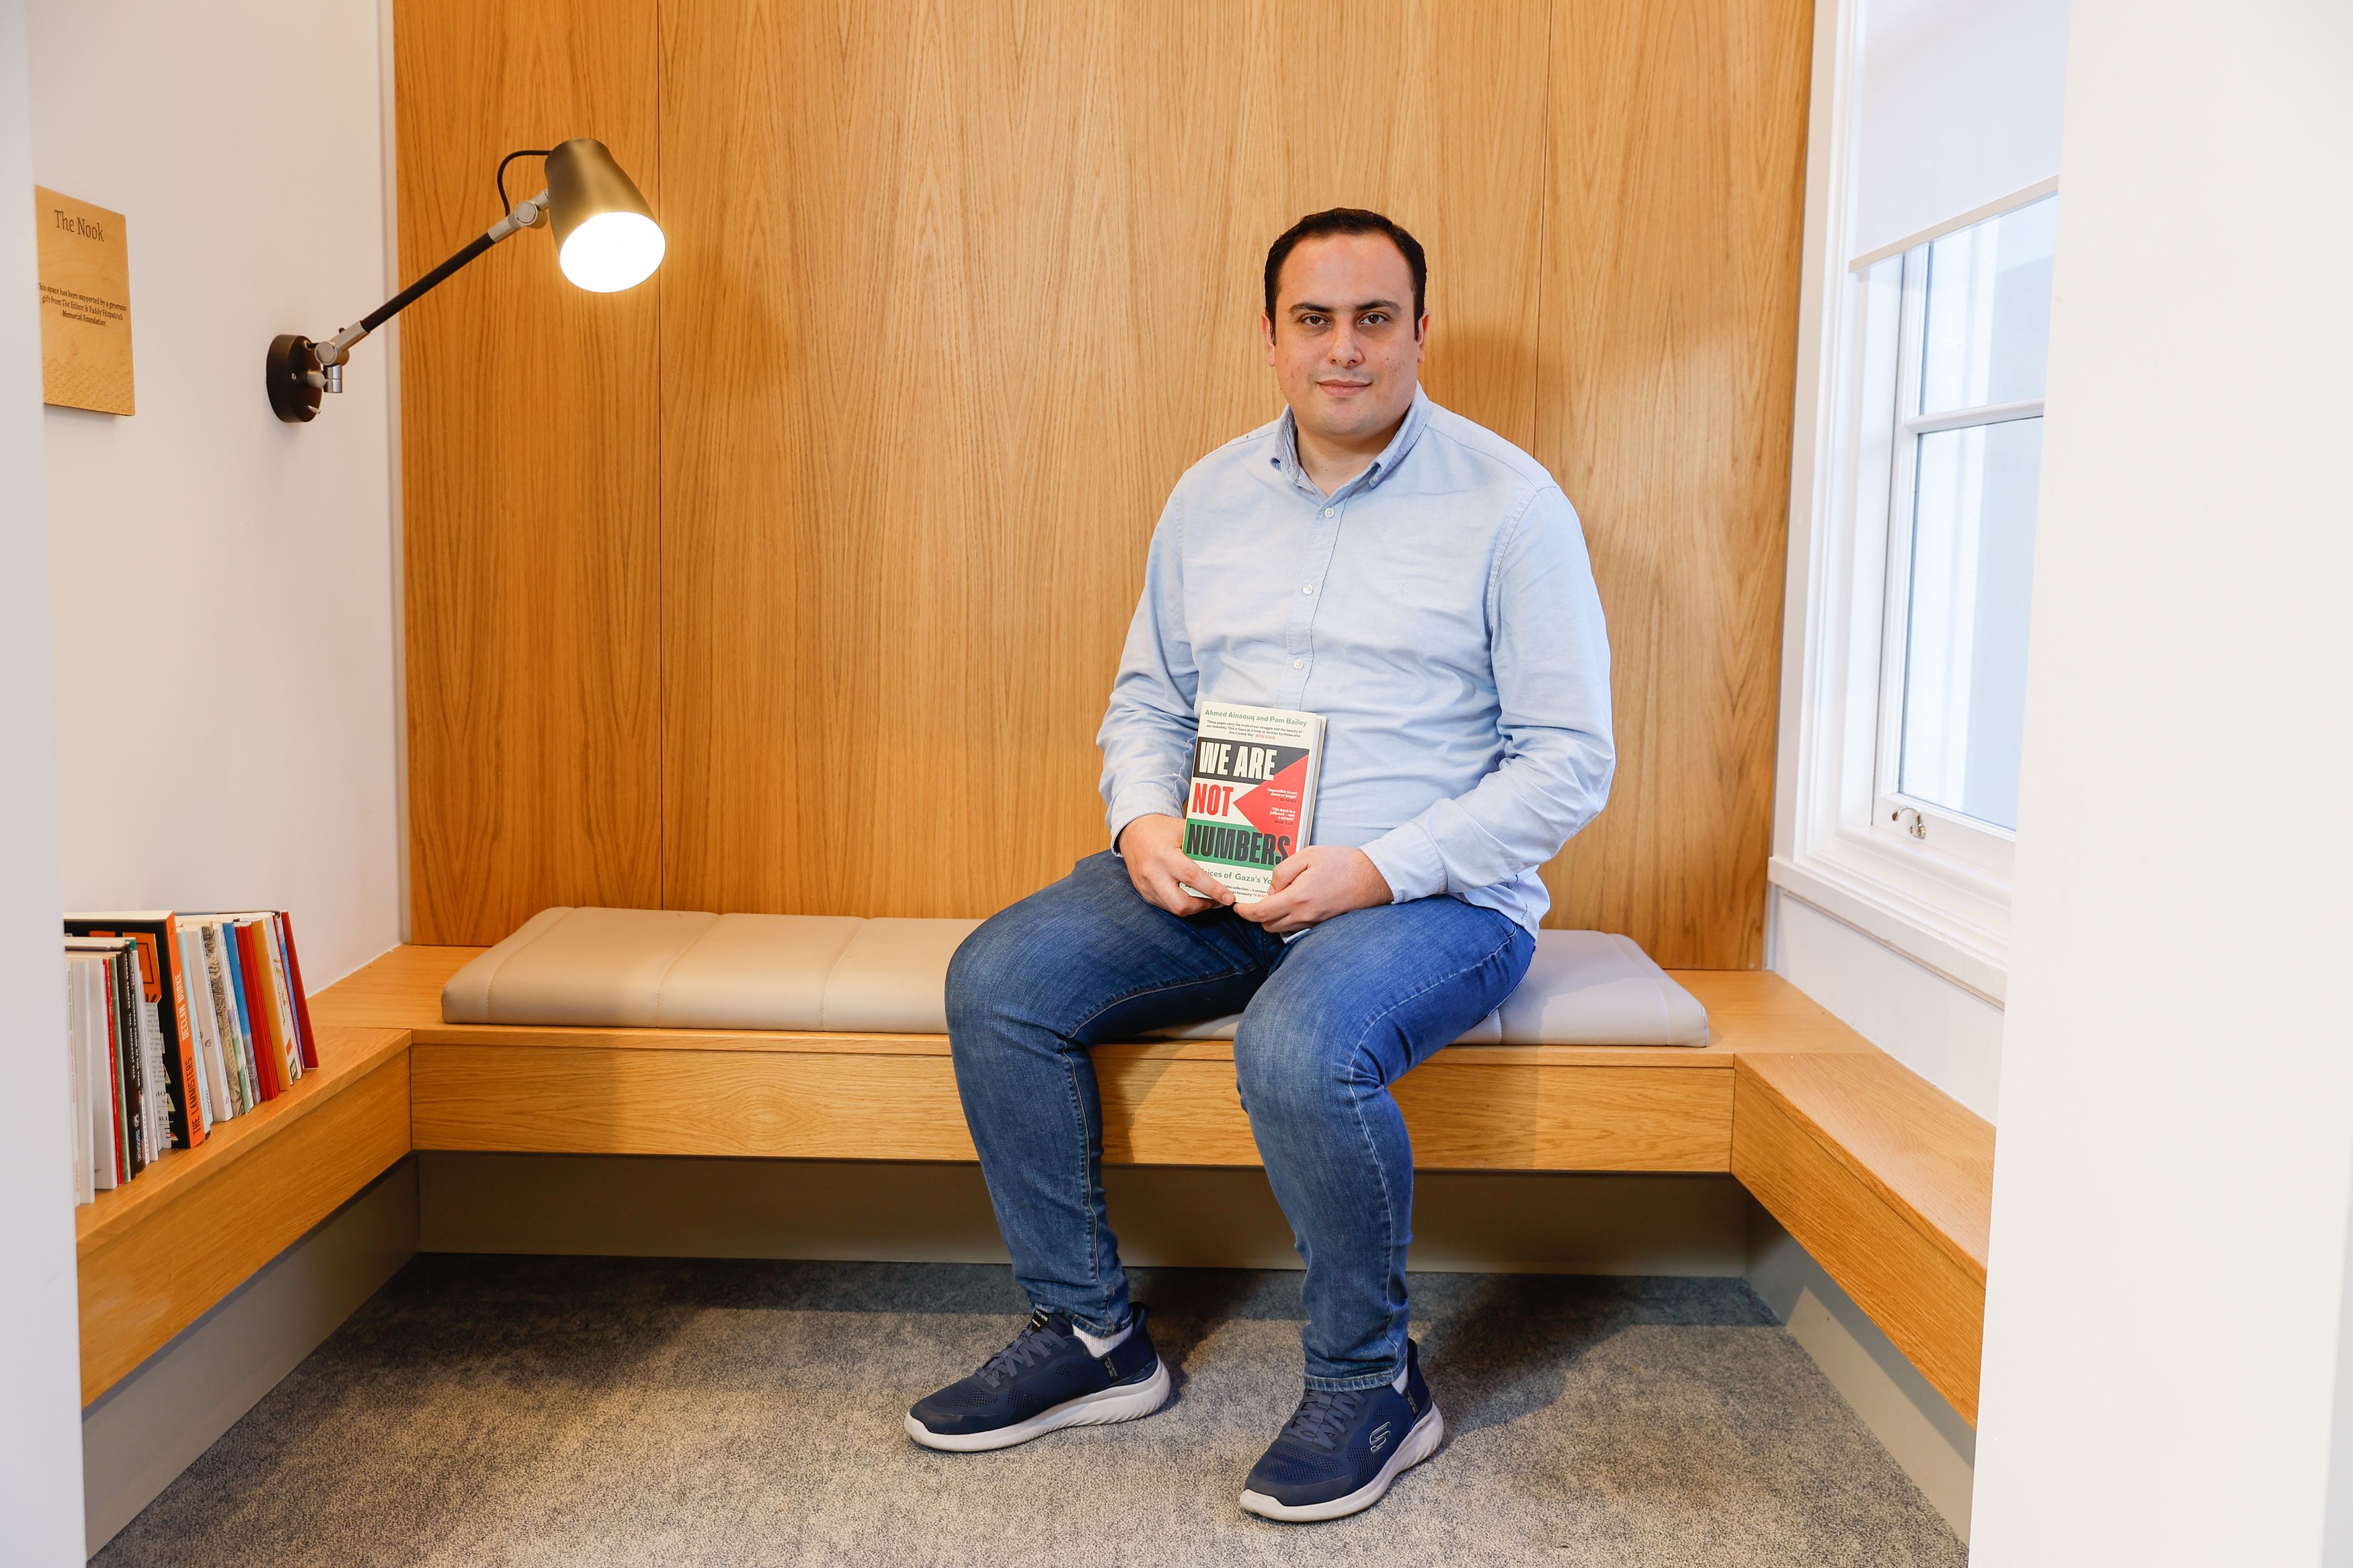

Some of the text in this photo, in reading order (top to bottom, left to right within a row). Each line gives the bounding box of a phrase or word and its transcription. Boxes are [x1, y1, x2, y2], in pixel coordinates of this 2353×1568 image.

[54, 210, 104, 242] The Nook
[51, 296, 61, 306] from
[62, 299, 70, 307] The
[89, 306, 102, 315] Paddy
[103, 309, 123, 320] Fitzpatrick
[68, 290, 78, 299] been
[79, 295, 99, 304] supported
[100, 298, 105, 307] by
[109, 302, 126, 311] generous
[63, 310, 106, 327] Memorial Foundation
[1228, 712, 1254, 721] Alnaouq
[1286, 718, 1307, 727] Bailey
[1199, 741, 1277, 781] WE ARE
[1192, 783, 1234, 817] NOT
[1187, 824, 1290, 865] NUMBERS
[1202, 868, 1222, 877] ices
[1235, 873, 1261, 883] Gaza's
[175, 971, 189, 1040] DECLAN BURKE
[186, 1057, 199, 1115] LAMMISTERS
[192, 1116, 201, 1136] THE
